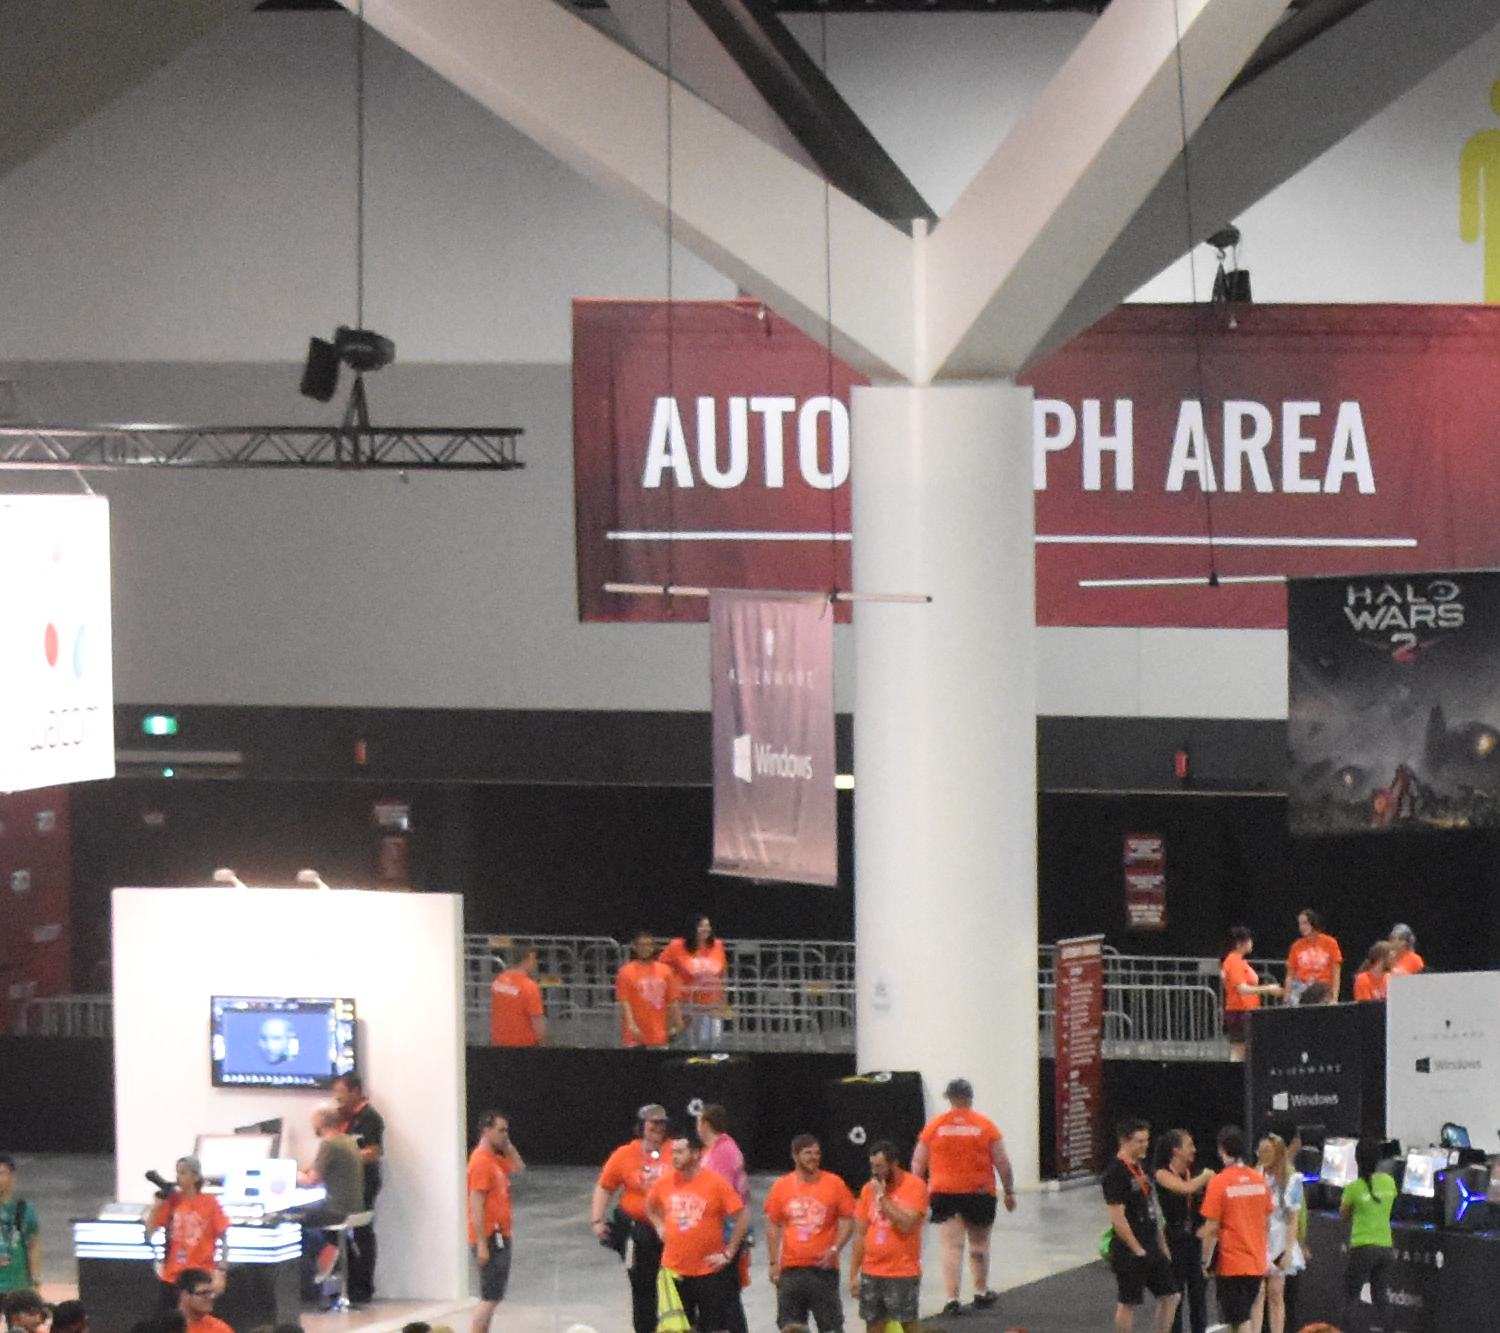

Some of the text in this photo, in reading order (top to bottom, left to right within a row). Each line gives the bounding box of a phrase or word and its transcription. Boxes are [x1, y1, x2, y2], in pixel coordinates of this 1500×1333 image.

[642, 396, 1377, 495] AUTOPH AREA
[1346, 580, 1460, 606] HALO
[1343, 604, 1464, 631] WARS
[1390, 632, 1417, 662] 2
[754, 744, 813, 780] Windows
[1291, 1092, 1340, 1108] Windows
